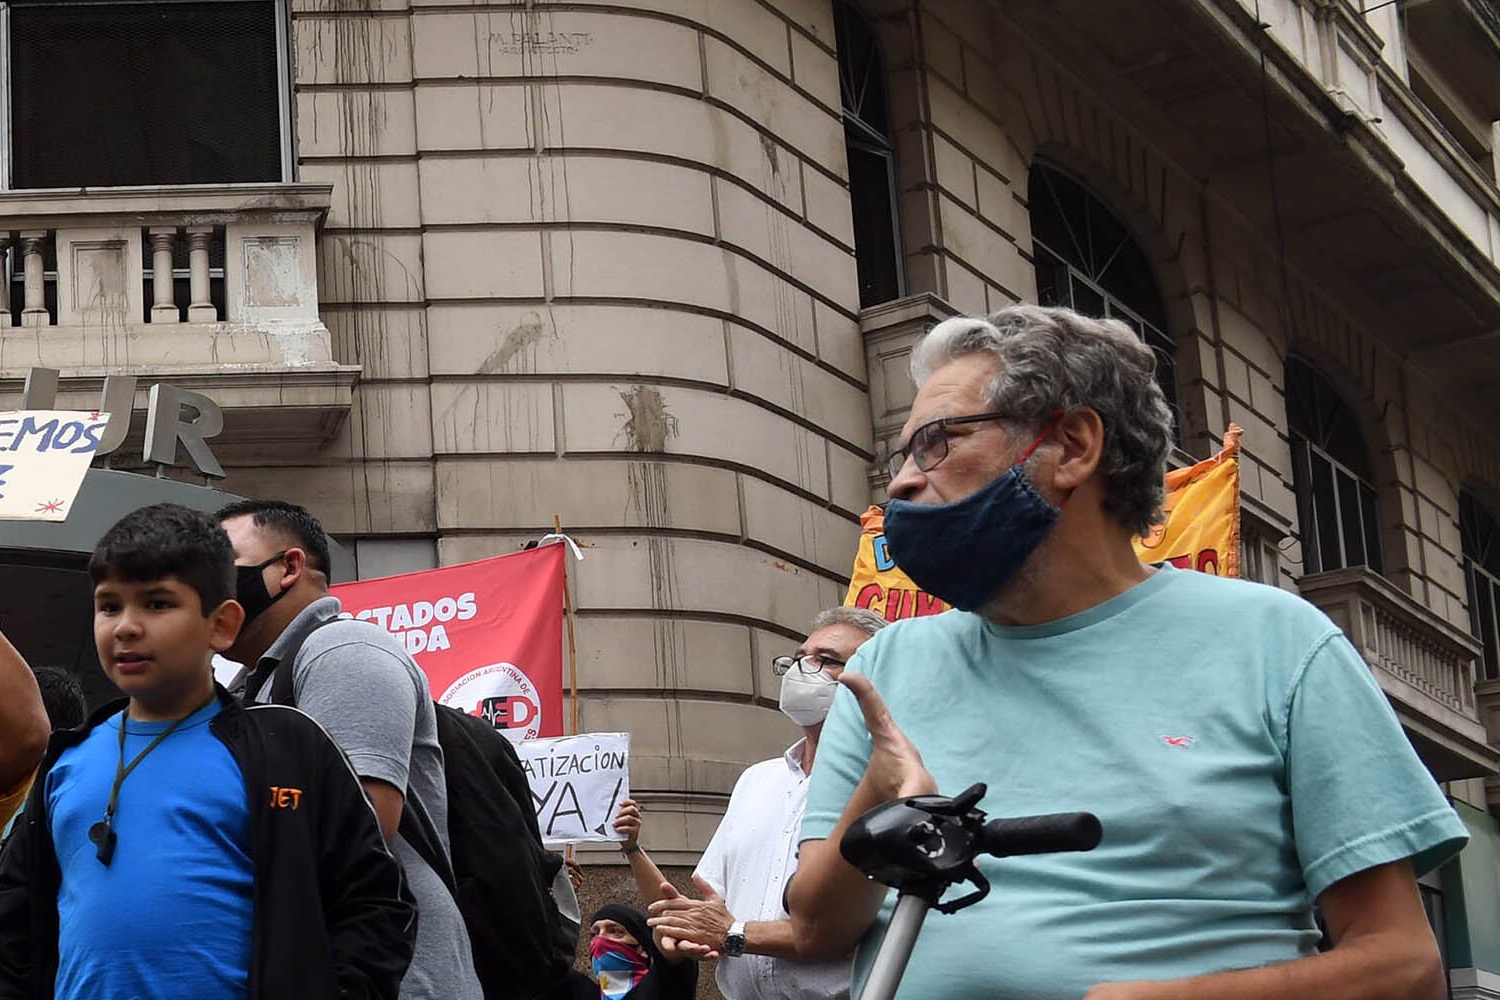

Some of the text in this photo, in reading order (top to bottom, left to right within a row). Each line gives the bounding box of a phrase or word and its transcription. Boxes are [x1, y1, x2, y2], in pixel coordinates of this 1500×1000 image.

[443, 672, 482, 704] SOCIACION
[519, 683, 531, 696] DE
[520, 745, 625, 780] ATIZACION
